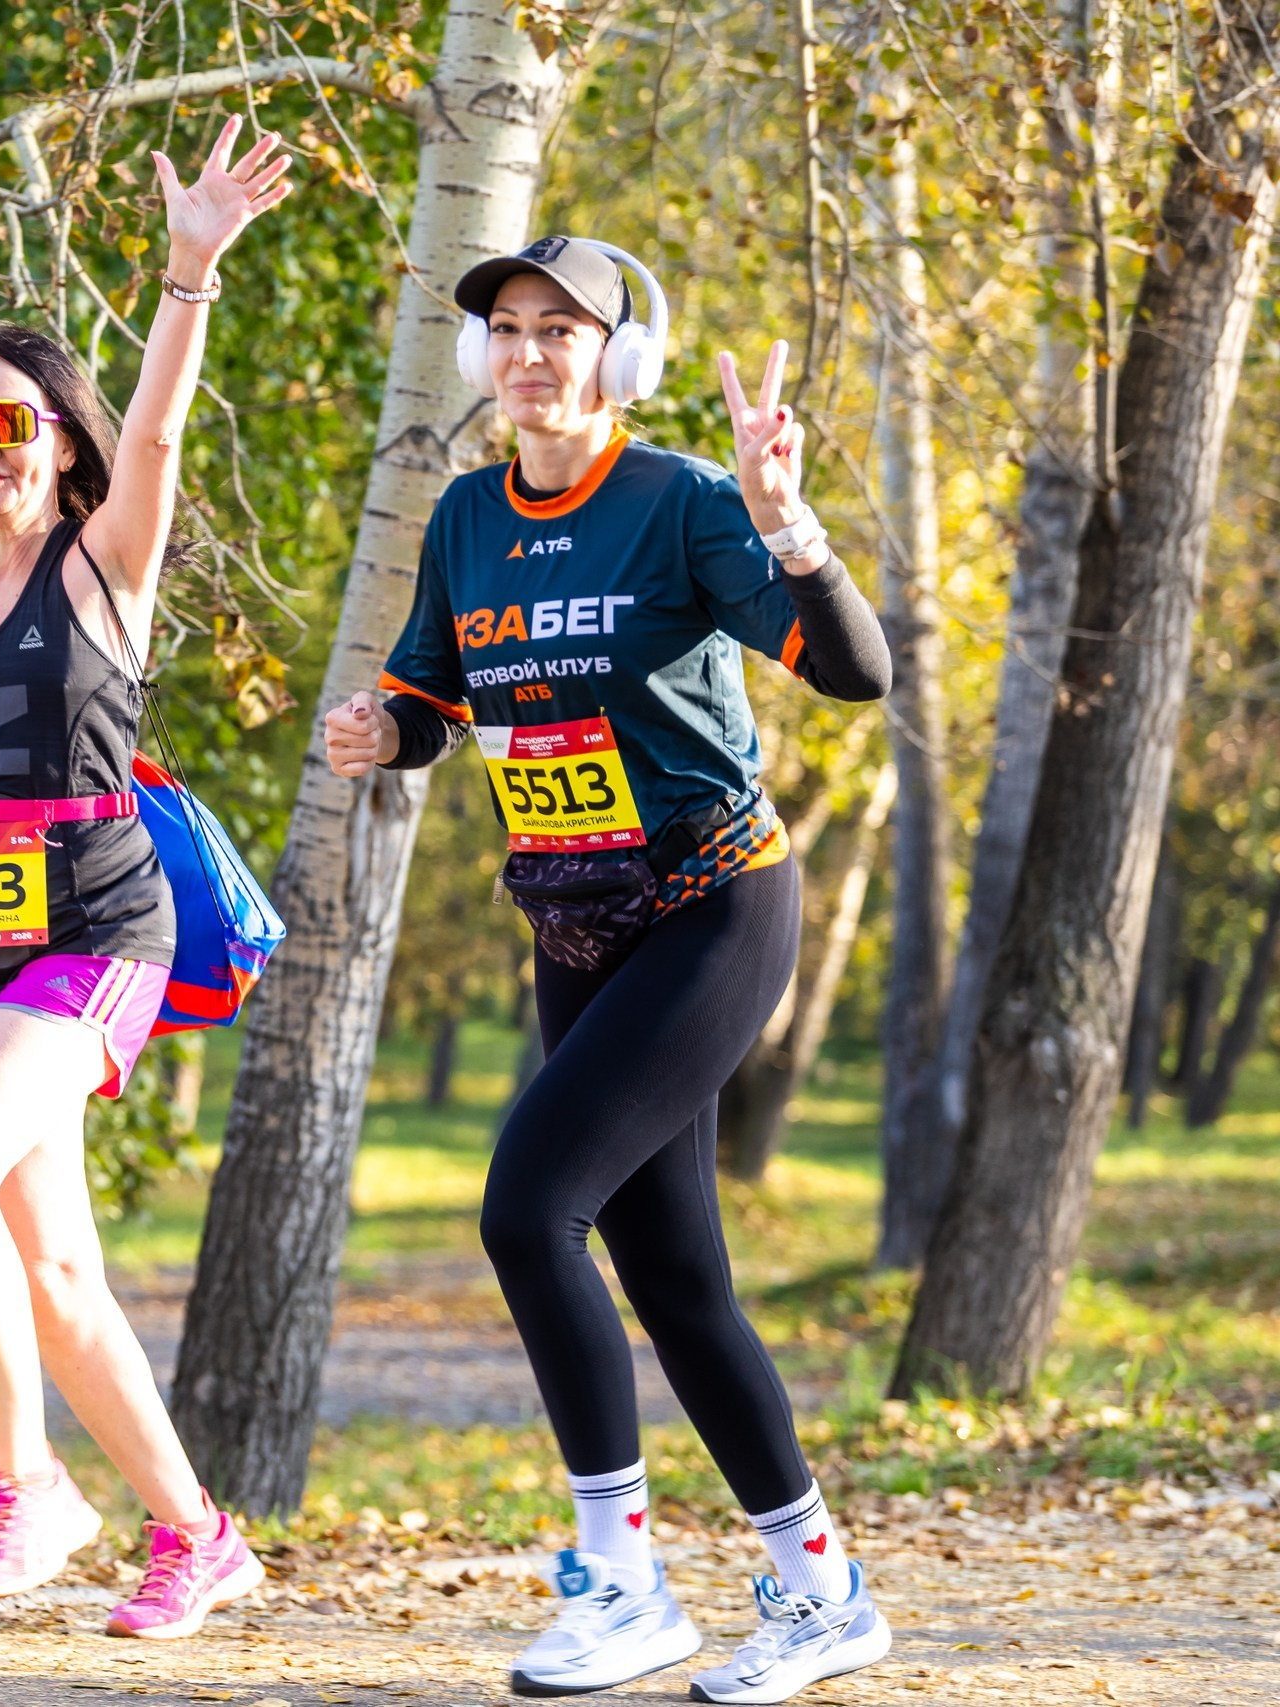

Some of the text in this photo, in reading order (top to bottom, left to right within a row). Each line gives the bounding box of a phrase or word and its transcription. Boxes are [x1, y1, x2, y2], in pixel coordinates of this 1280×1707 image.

[529, 536, 573, 555] АТБ
[545, 656, 613, 677] КЛУБ
[514, 684, 553, 703] АТБ
[501, 762, 617, 816] 5513
[522, 814, 617, 828] БАЙКАЛОВА КРИСТИНА
